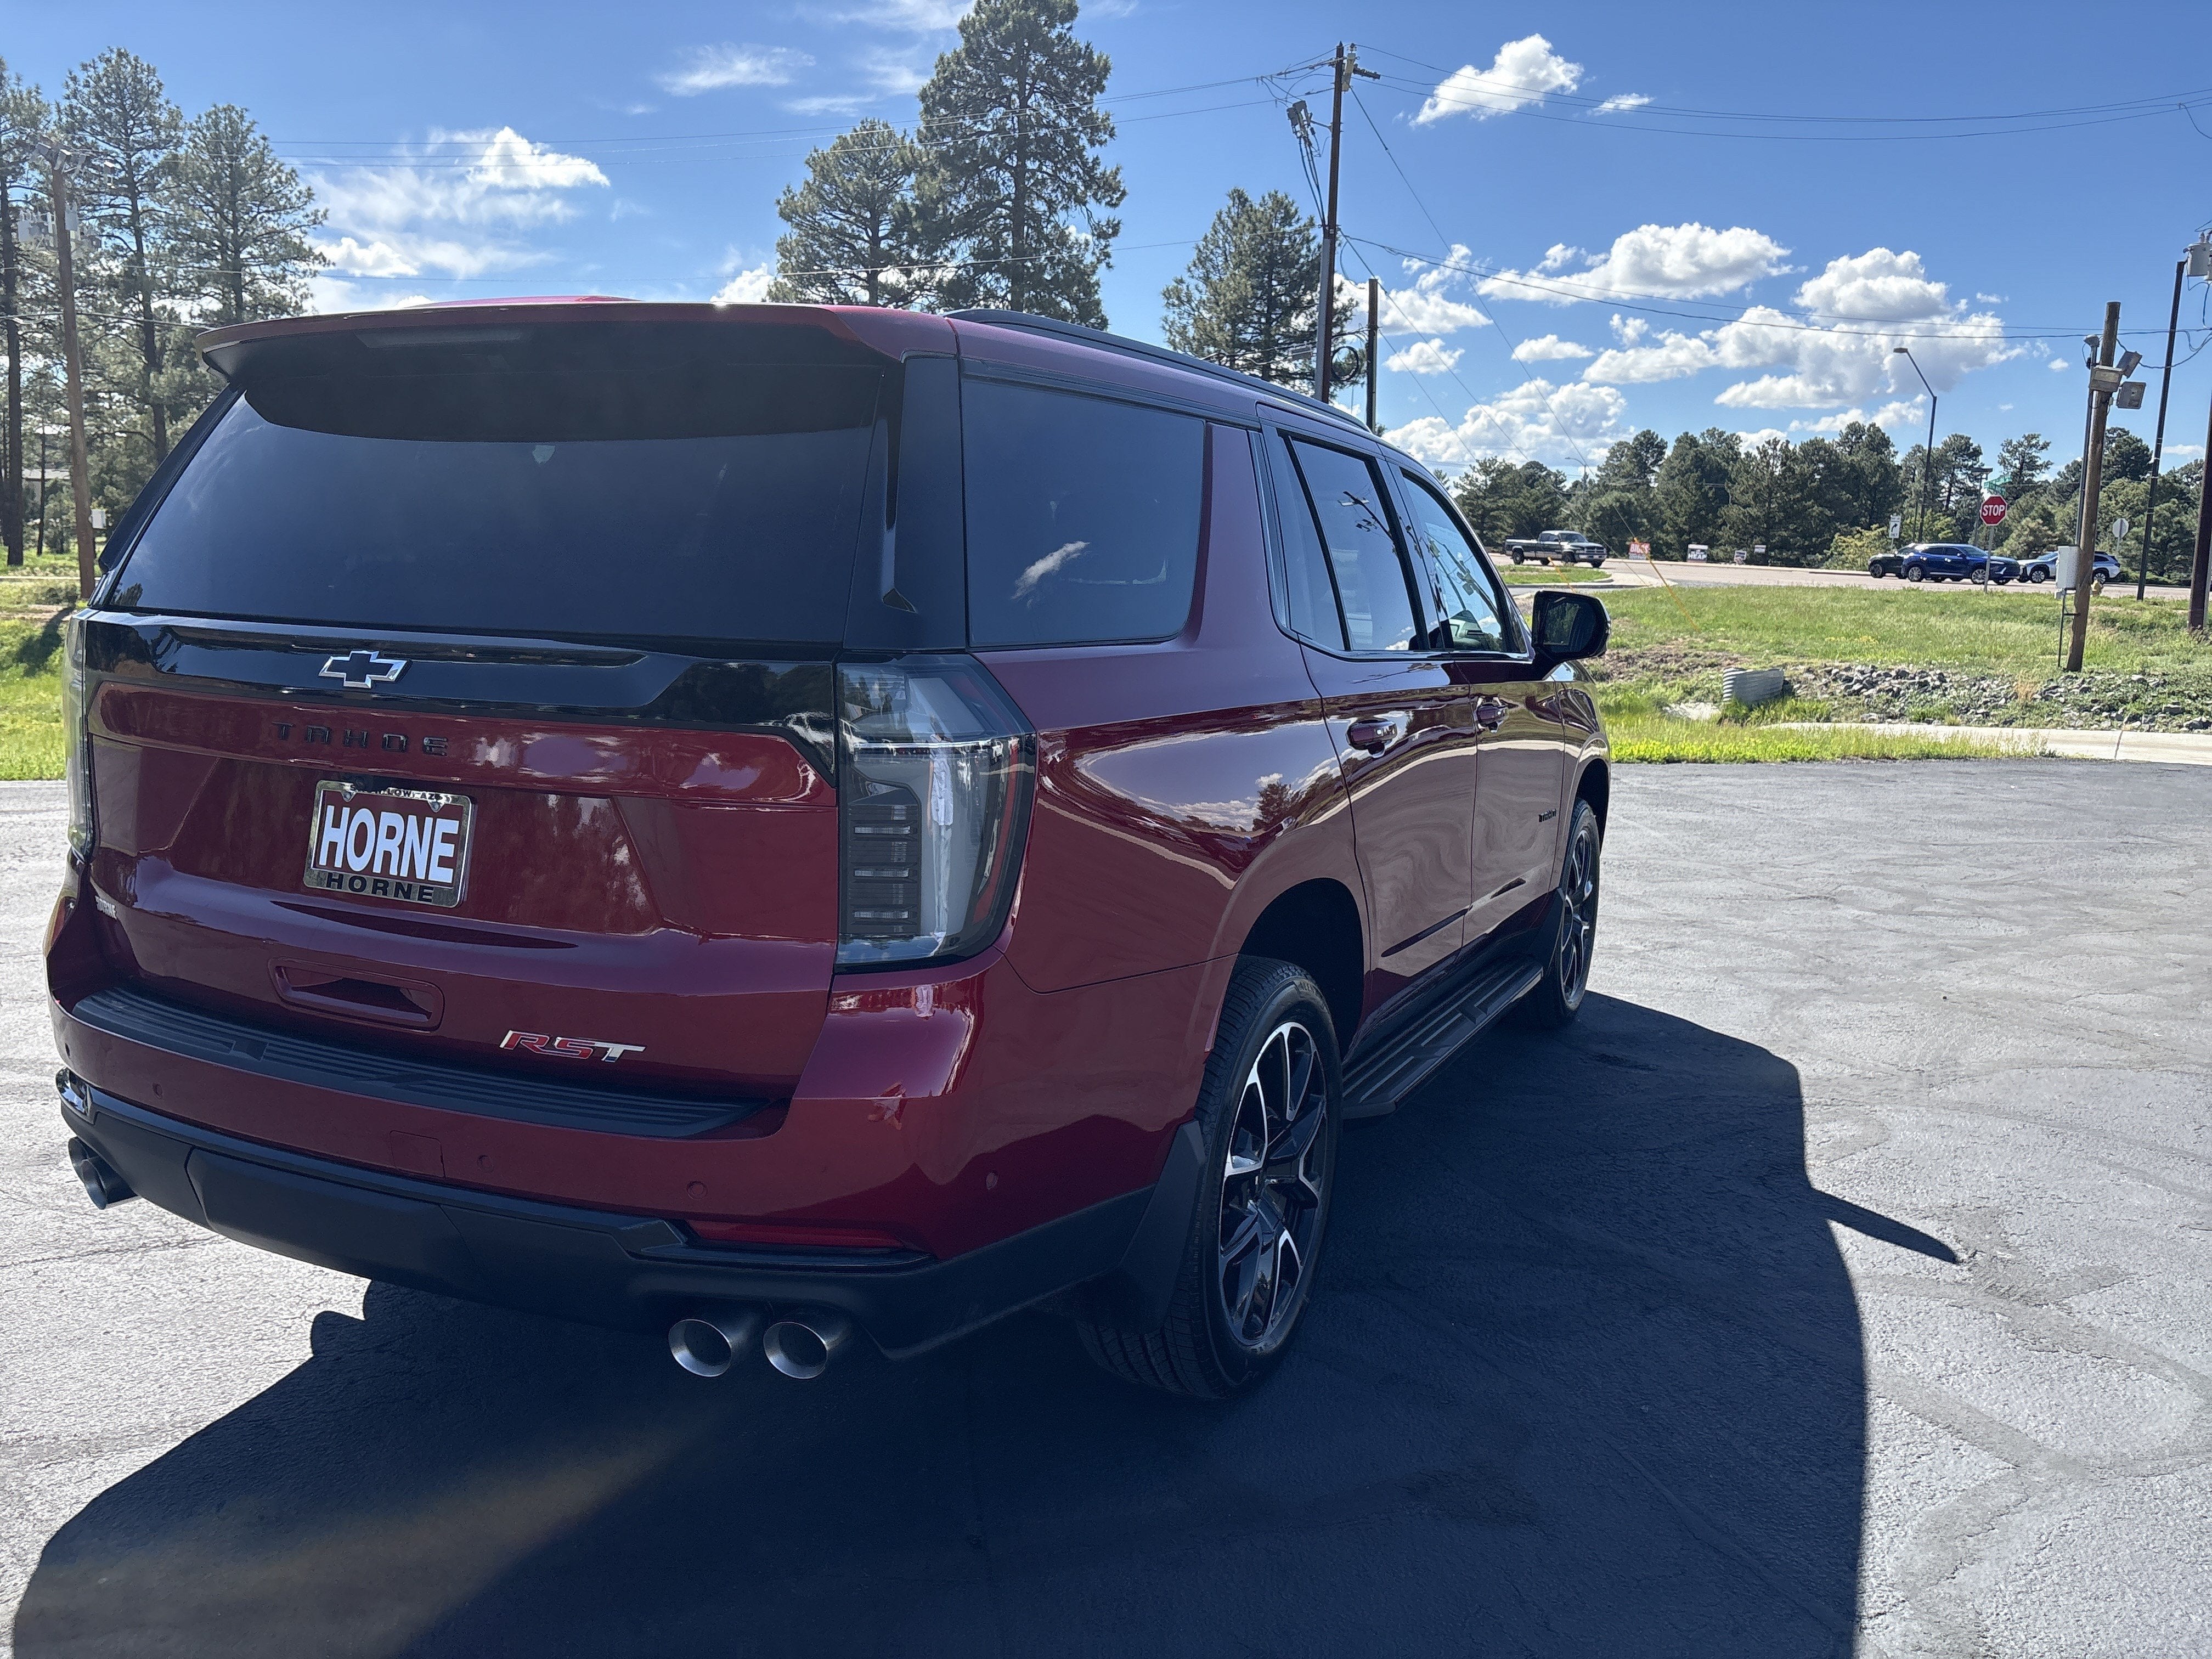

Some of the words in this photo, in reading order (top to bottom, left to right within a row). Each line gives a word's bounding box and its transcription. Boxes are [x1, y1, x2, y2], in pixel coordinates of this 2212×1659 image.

[1982, 504, 2005, 516] STOP
[272, 721, 448, 757] TAHOE
[319, 805, 460, 883] HORNE
[326, 872, 435, 903] HORNE
[499, 1030, 646, 1063] RST
